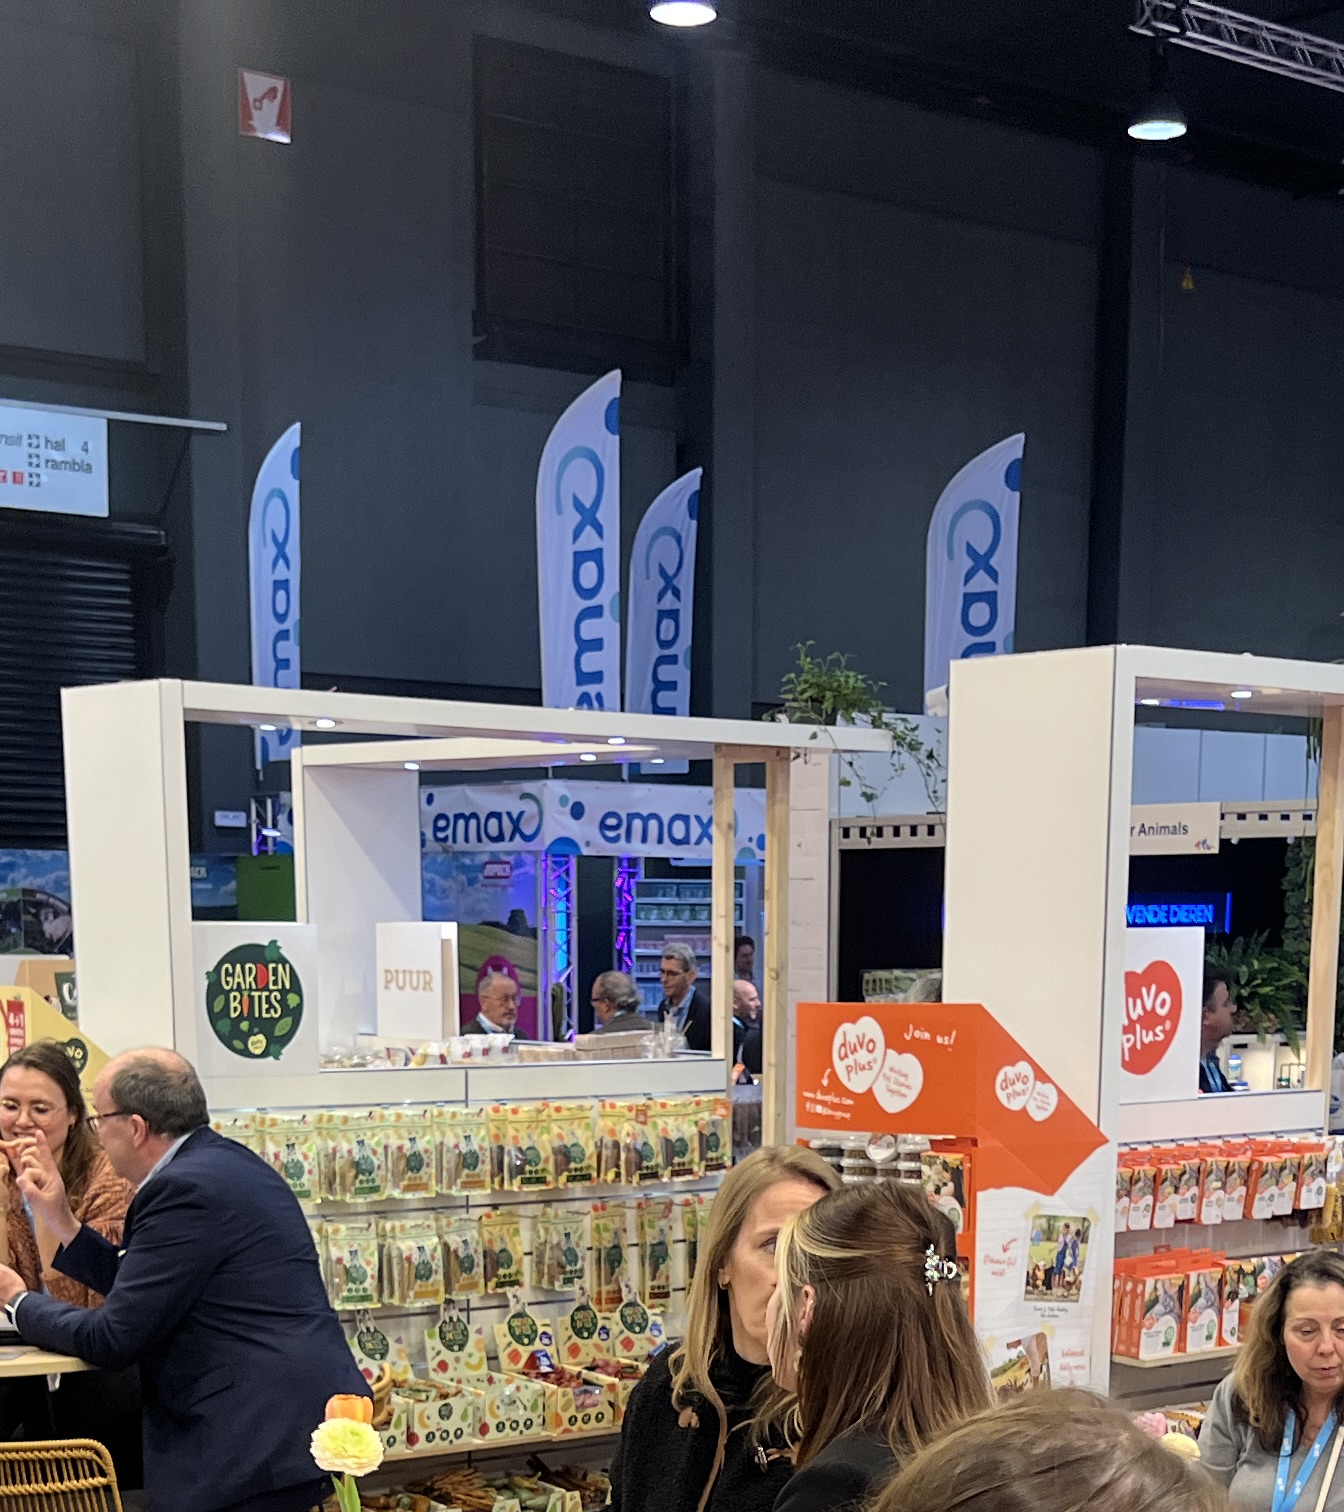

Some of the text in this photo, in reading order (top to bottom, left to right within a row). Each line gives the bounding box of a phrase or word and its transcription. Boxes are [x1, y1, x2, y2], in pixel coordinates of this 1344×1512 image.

[44, 436, 66, 453] hal
[80, 440, 90, 455] 4
[44, 455, 93, 475] rambla
[432, 793, 543, 844] emax
[1138, 822, 1189, 837] Animals
[220, 963, 291, 990] GARDEN
[383, 969, 434, 992] PUUR
[229, 990, 283, 1018] BITES
[904, 1024, 931, 1041] Join
[838, 1031, 877, 1061] duvo
[1000, 1072, 1029, 1092] duvo
